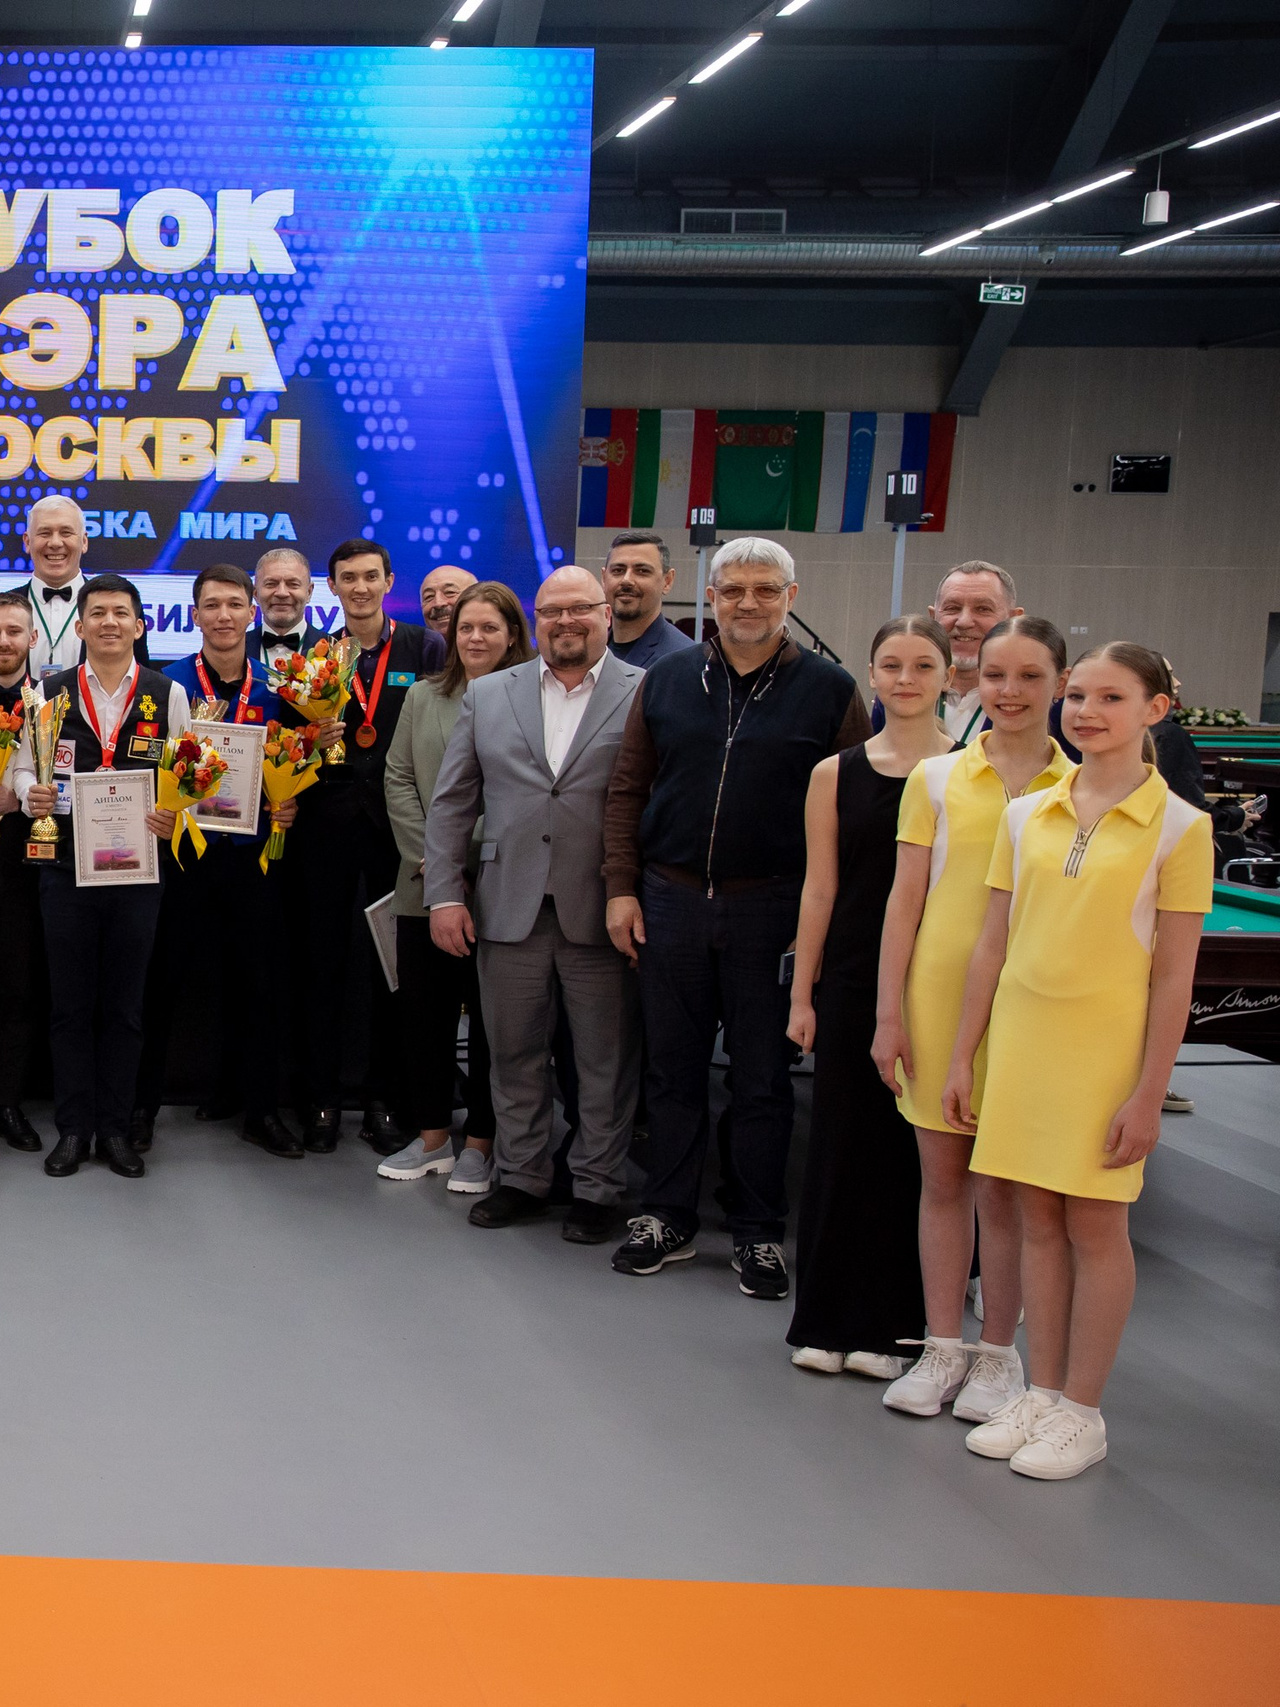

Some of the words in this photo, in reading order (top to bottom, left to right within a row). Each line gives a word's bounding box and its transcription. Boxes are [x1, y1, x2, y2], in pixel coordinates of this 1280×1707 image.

[902, 474, 917, 494] 10
[700, 508, 714, 525] 09
[179, 512, 298, 540] МИРА
[213, 746, 244, 755] ИПЛОМ
[94, 796, 132, 804] ДИПЛОМ
